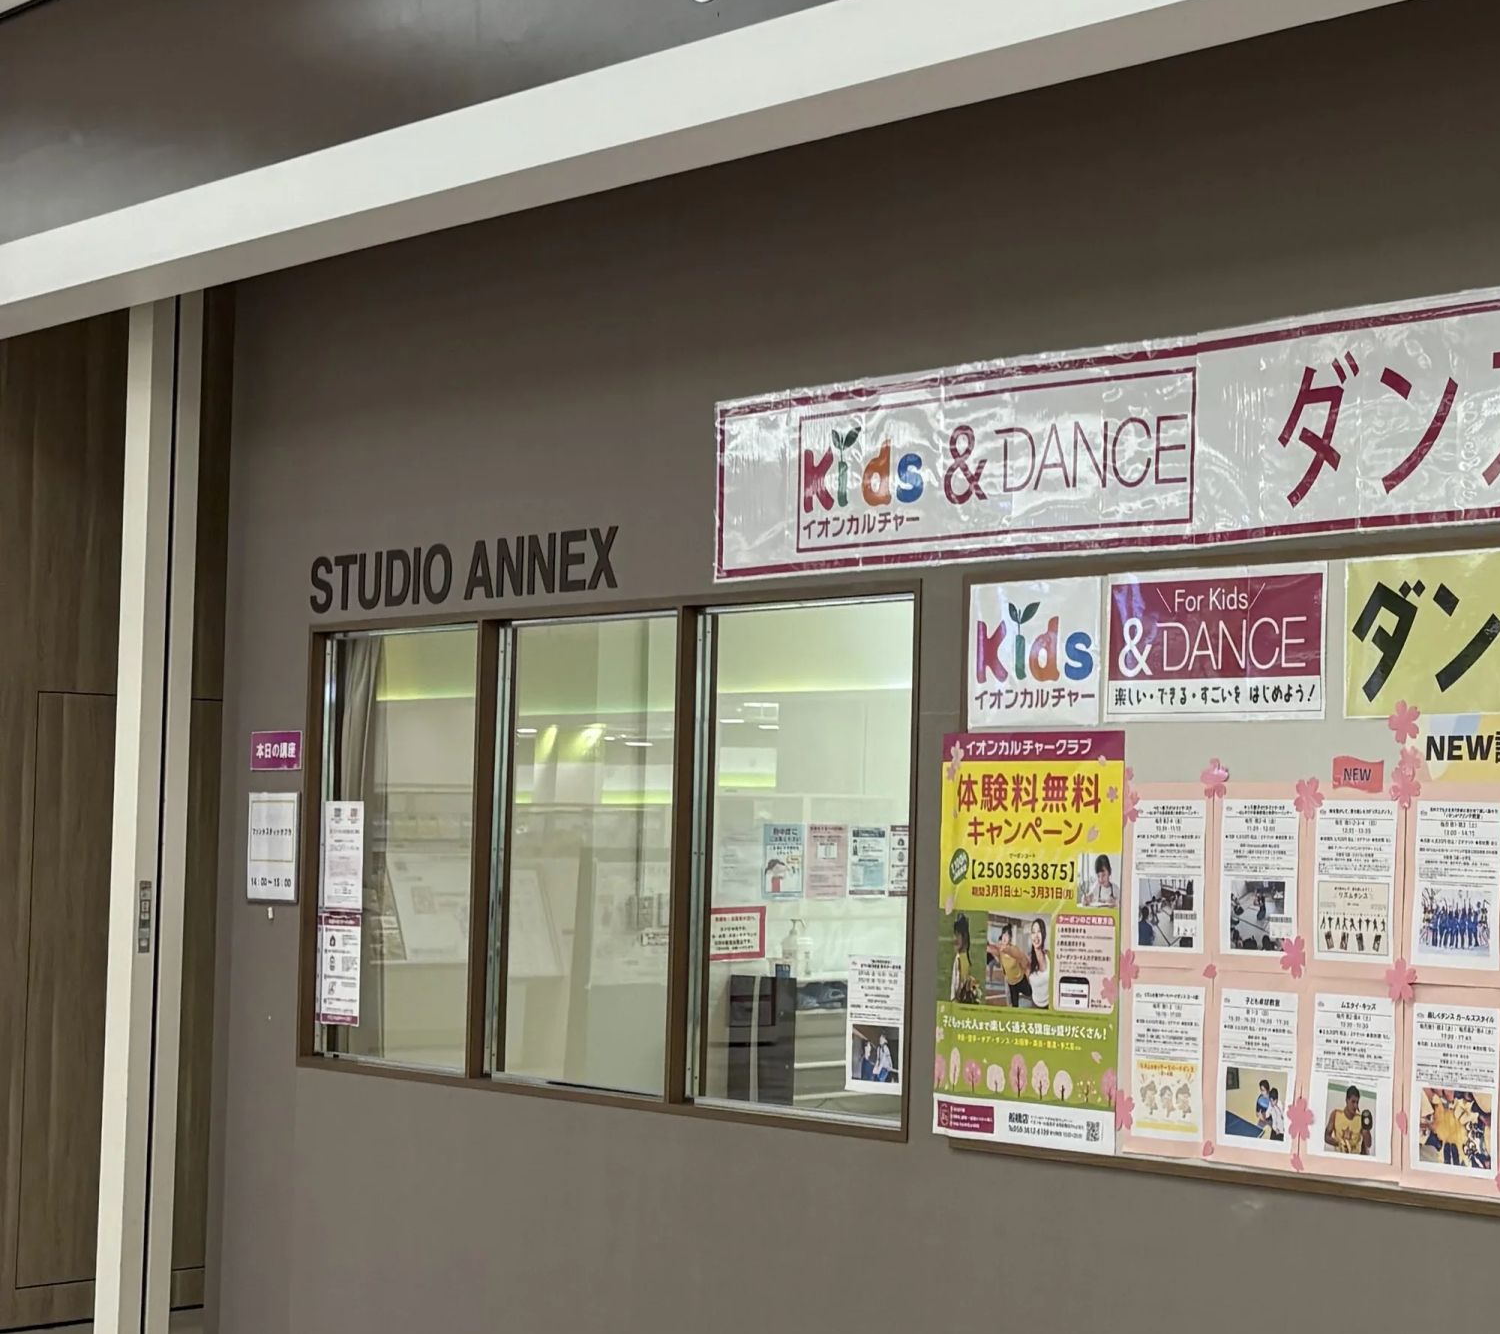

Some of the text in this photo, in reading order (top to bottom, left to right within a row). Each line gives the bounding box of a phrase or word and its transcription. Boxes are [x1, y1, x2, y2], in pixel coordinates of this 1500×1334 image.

[803, 413, 1188, 514] Kids & DANCE
[802, 512, 920, 540] イオンカルチャー
[309, 525, 619, 614] STUDIO ANNEX
[1175, 587, 1248, 612] For Kids
[976, 606, 1094, 683] Kids
[1118, 616, 1307, 678] & DANCE
[974, 687, 1095, 710] イオンカルチャー
[1114, 684, 1241, 706] 楽しい・できる・すごいを
[256, 742, 296, 759] 本日の講座
[966, 738, 1092, 756] イオンカルチャークラブ
[1343, 767, 1372, 781] NEW
[957, 773, 1101, 814] 体験料無料
[967, 816, 1083, 846] キャンペーン
[1008, 1112, 1029, 1124] 船橋店
